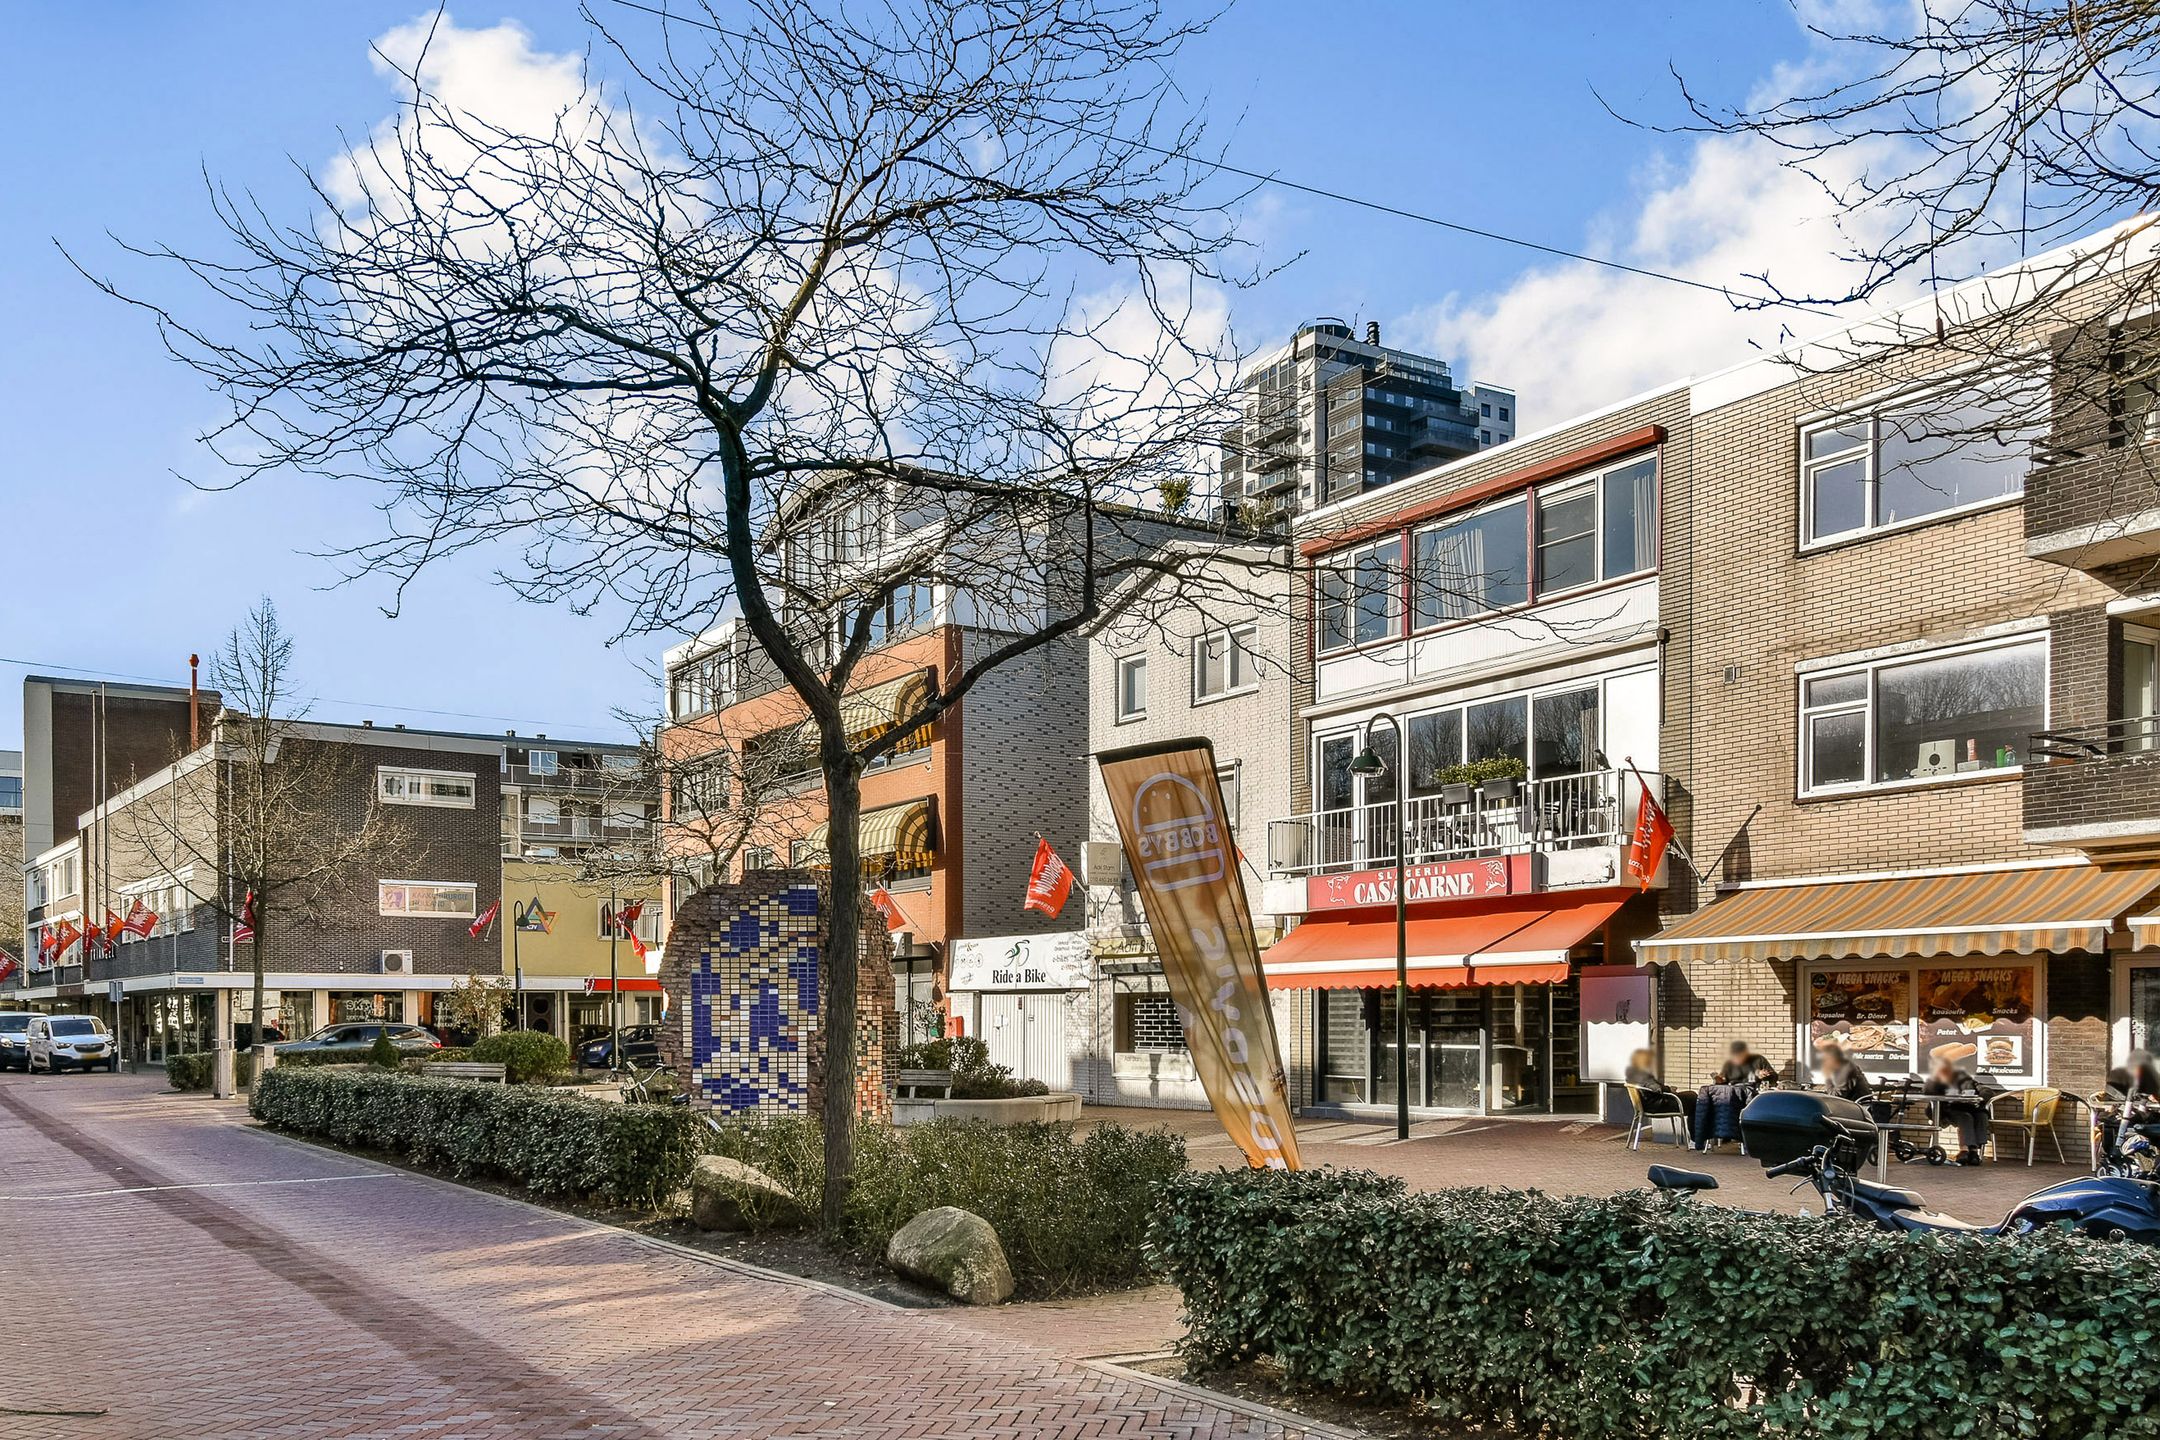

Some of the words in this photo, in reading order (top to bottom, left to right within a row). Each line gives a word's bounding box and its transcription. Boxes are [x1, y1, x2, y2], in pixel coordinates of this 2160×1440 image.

[1378, 866, 1446, 880] SLGERIJ
[1404, 873, 1475, 900] CARNE
[992, 970, 1013, 983] Ride
[1016, 972, 1021, 982] a
[1024, 969, 1046, 983] Bike
[1836, 973, 1862, 984] MEGA
[1865, 973, 1900, 984] SNACKS
[1941, 970, 1969, 982] MEGA
[1974, 970, 2012, 981] SNACKS
